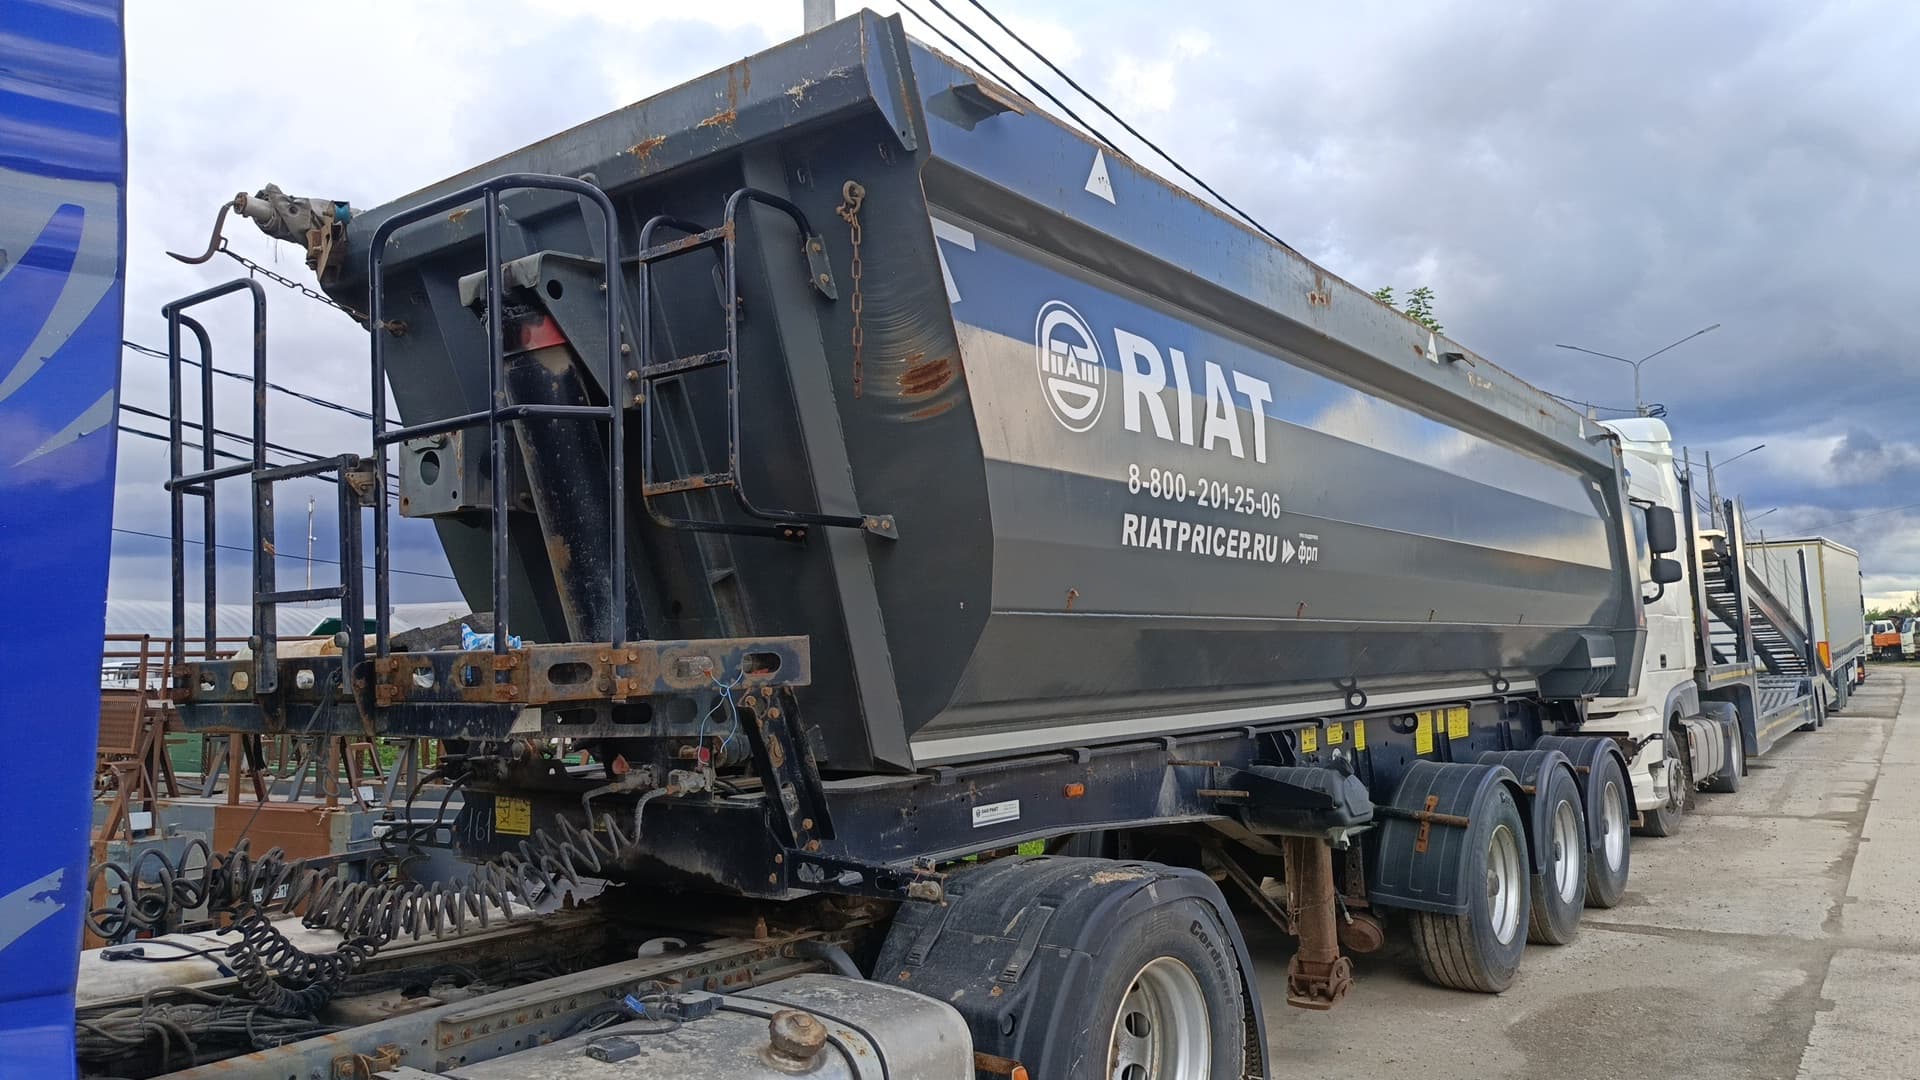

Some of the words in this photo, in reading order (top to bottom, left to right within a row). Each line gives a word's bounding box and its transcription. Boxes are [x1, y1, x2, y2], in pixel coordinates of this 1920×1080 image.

[1114, 328, 1272, 463] RIAT
[1129, 464, 1281, 519] 8-800-201-25-06
[1122, 514, 1277, 564] RIATPRICEP.RU
